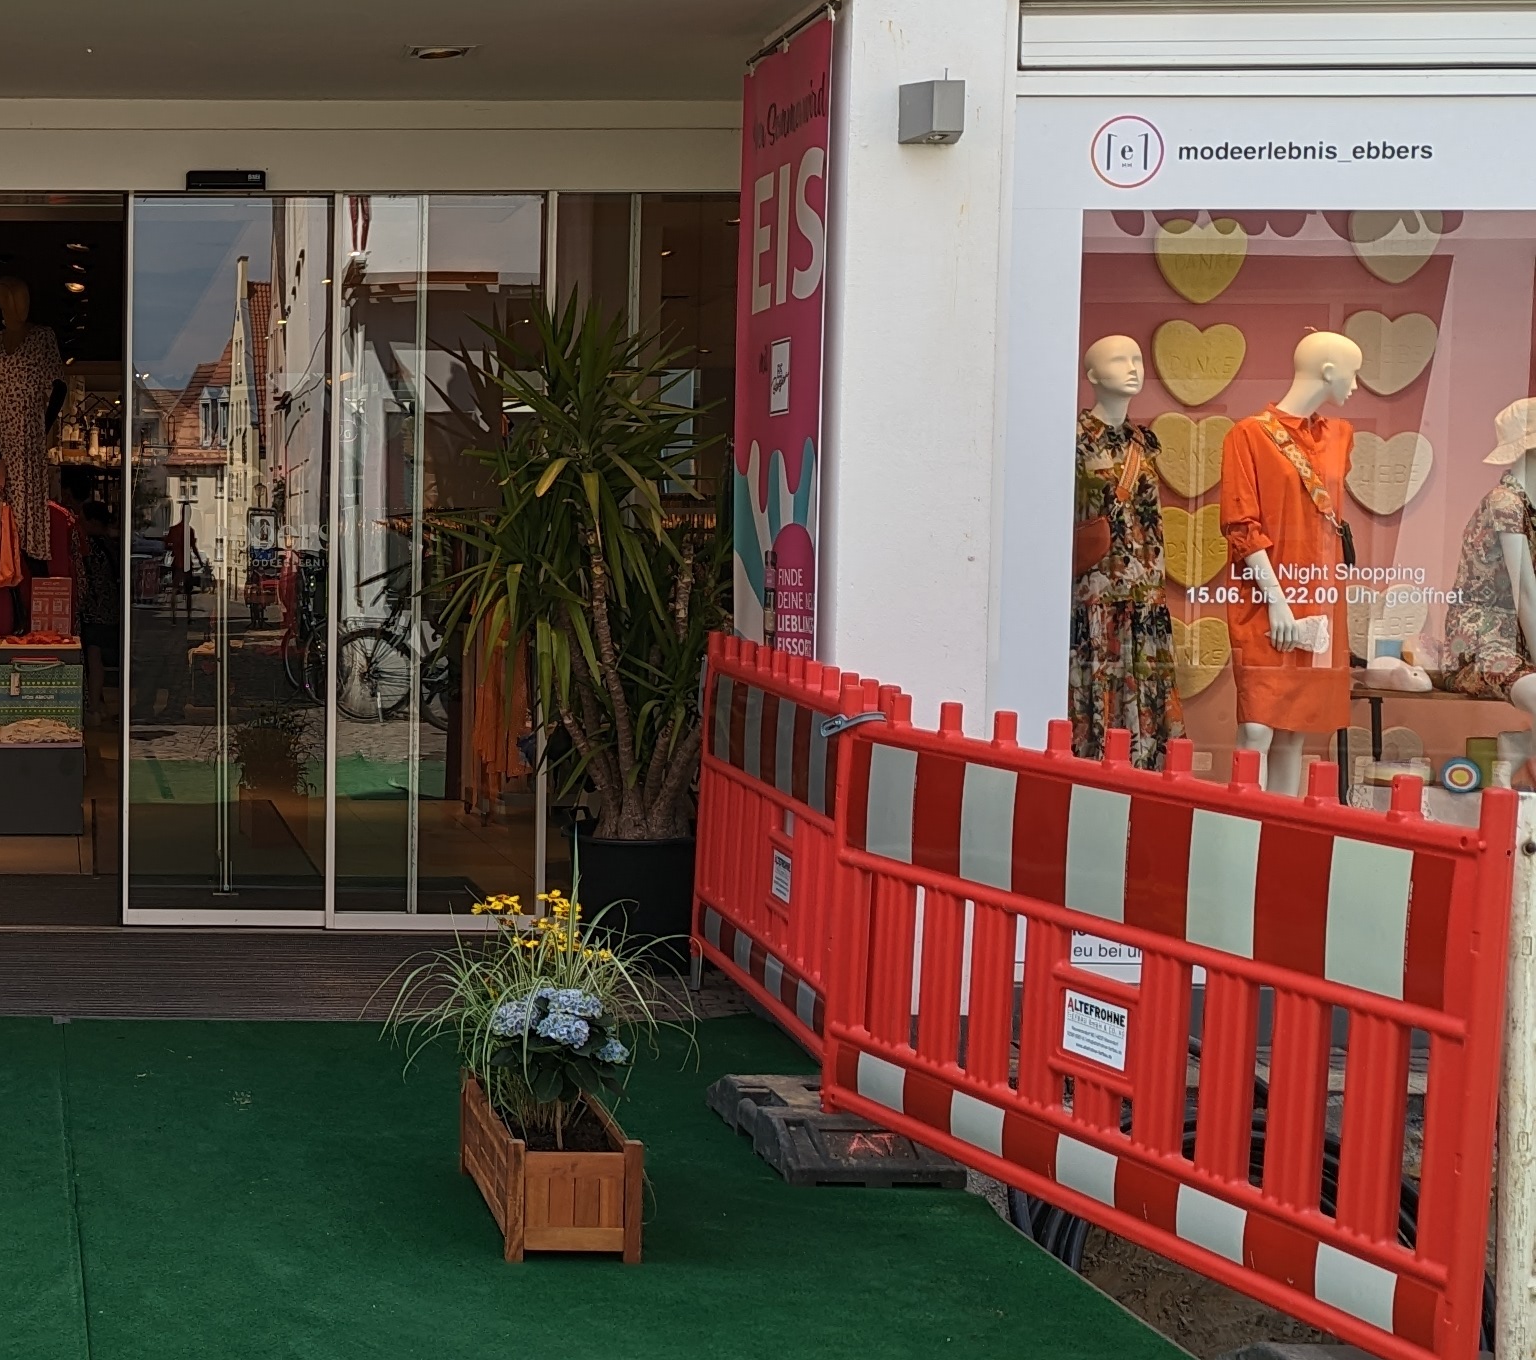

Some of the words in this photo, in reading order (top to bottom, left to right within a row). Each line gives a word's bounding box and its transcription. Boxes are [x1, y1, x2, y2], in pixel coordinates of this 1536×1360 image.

[1178, 141, 1433, 163] modeerlebnis_ebbers
[751, 146, 825, 316] EIS
[778, 568, 804, 587] FINDE
[1231, 563, 1268, 582] Late
[1278, 562, 1329, 585] Night
[1334, 562, 1426, 585] Shopping
[777, 591, 804, 610] DEINE
[1186, 587, 1245, 604] 15.06.
[1251, 587, 1278, 604] bis
[1285, 587, 1339, 604] 22.00
[1345, 587, 1380, 604] Uhr
[1385, 587, 1464, 608] geöffnet
[1098, 943, 1122, 958] bei
[1067, 996, 1126, 1028] ALTEFROHNE
